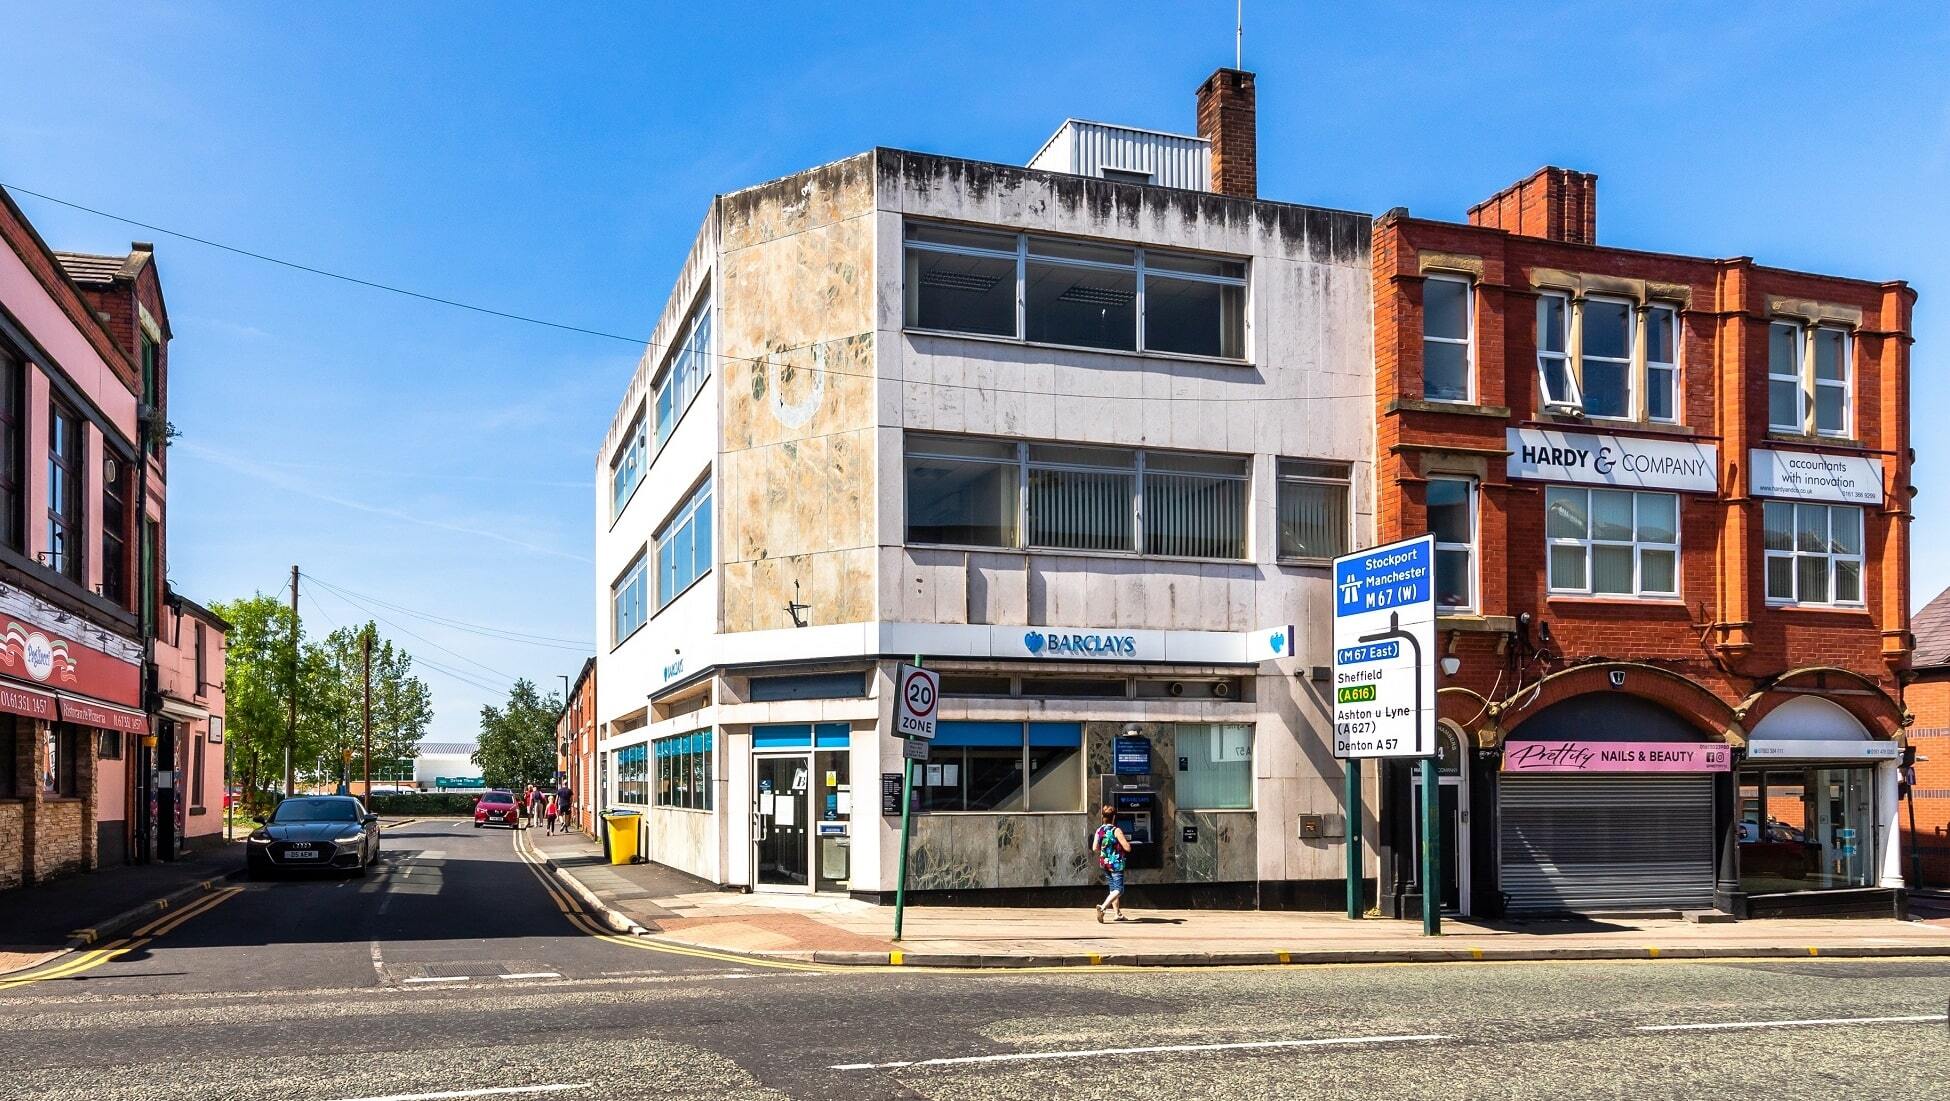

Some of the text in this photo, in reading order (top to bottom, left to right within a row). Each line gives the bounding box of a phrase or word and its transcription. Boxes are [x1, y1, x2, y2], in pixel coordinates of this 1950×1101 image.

[1522, 445, 1705, 477] HARDY & COMPANY
[1789, 459, 1847, 472] accountants
[1781, 471, 1855, 488] with innovation
[1365, 548, 1418, 571] Stockport
[1366, 567, 1427, 588] Manchester
[1398, 583, 1417, 603] (W)
[1047, 634, 1135, 653] BARCLAYS
[1369, 642, 1398, 659] East)
[1337, 668, 1383, 684] Sheffield
[0, 690, 18, 709] 0161
[18, 694, 30, 711] 351
[909, 684, 932, 705] 20
[1337, 706, 1410, 721] Ashton u Lyne
[902, 716, 932, 733] ZONE
[1338, 740, 1373, 751] Denton
[1510, 742, 1597, 770] Prettify
[1601, 751, 1635, 762] NAILS
[1638, 751, 1646, 762] &
[1649, 751, 1694, 762] BEAUTY
